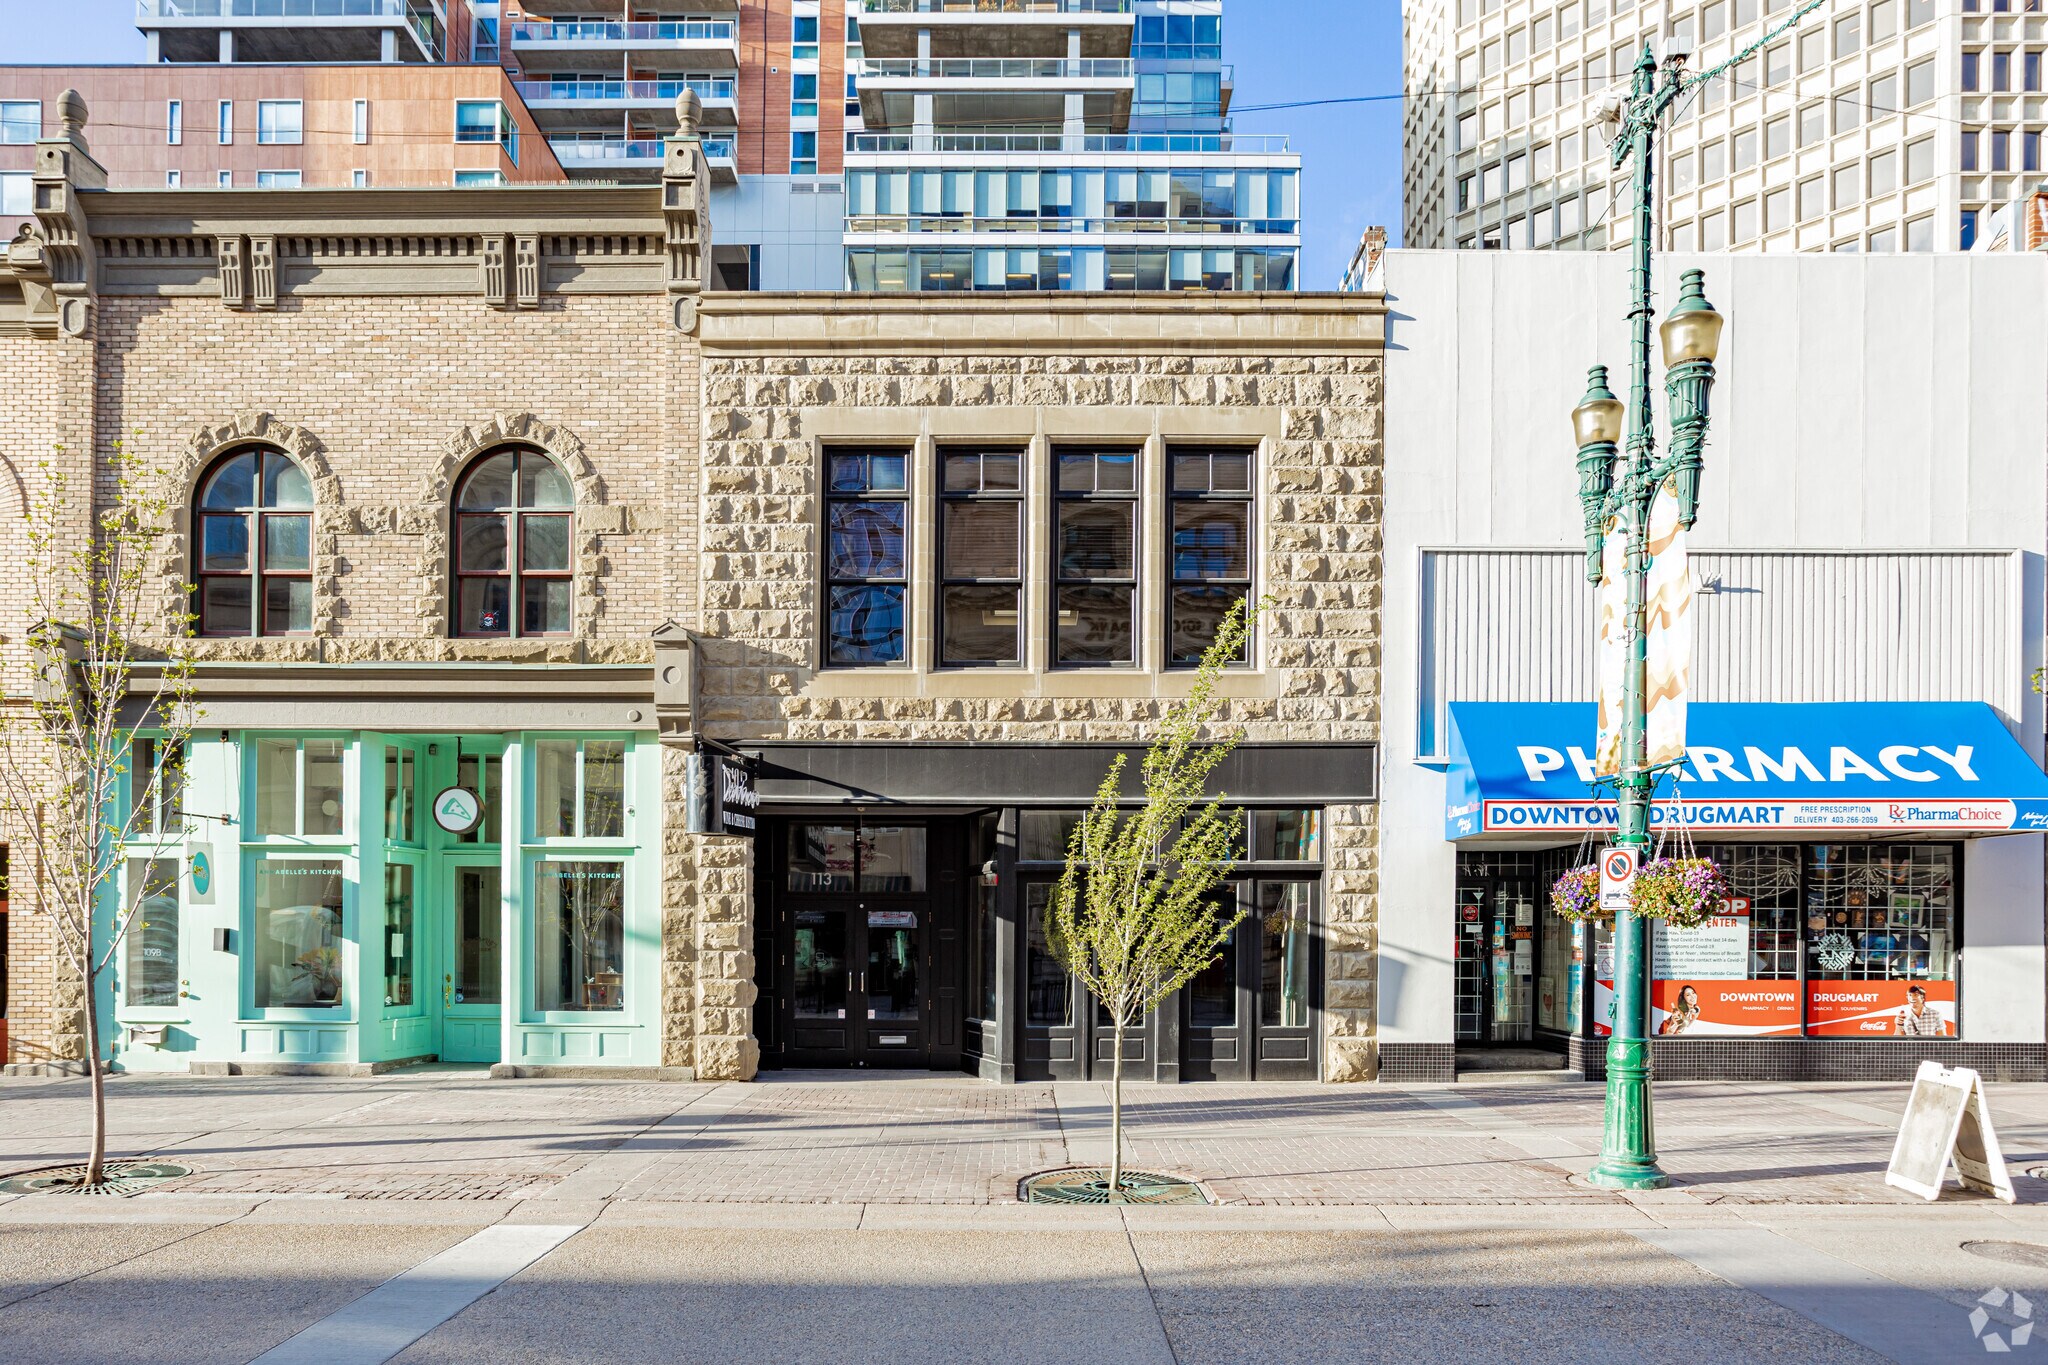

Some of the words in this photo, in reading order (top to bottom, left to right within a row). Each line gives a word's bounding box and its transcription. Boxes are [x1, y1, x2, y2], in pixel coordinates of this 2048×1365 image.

[1516, 745, 1980, 782] PHRMACY
[1492, 807, 1620, 824] DOWNTOW
[1652, 806, 1783, 824] DRUGMART
[1907, 807, 2002, 821] PharmaChoice
[811, 872, 832, 885] 113
[1706, 918, 1737, 928] ENTER
[144, 948, 162, 957] 109B
[1720, 992, 1795, 1002] DOWNTOWN
[1813, 993, 1879, 1002] DRUGMART
